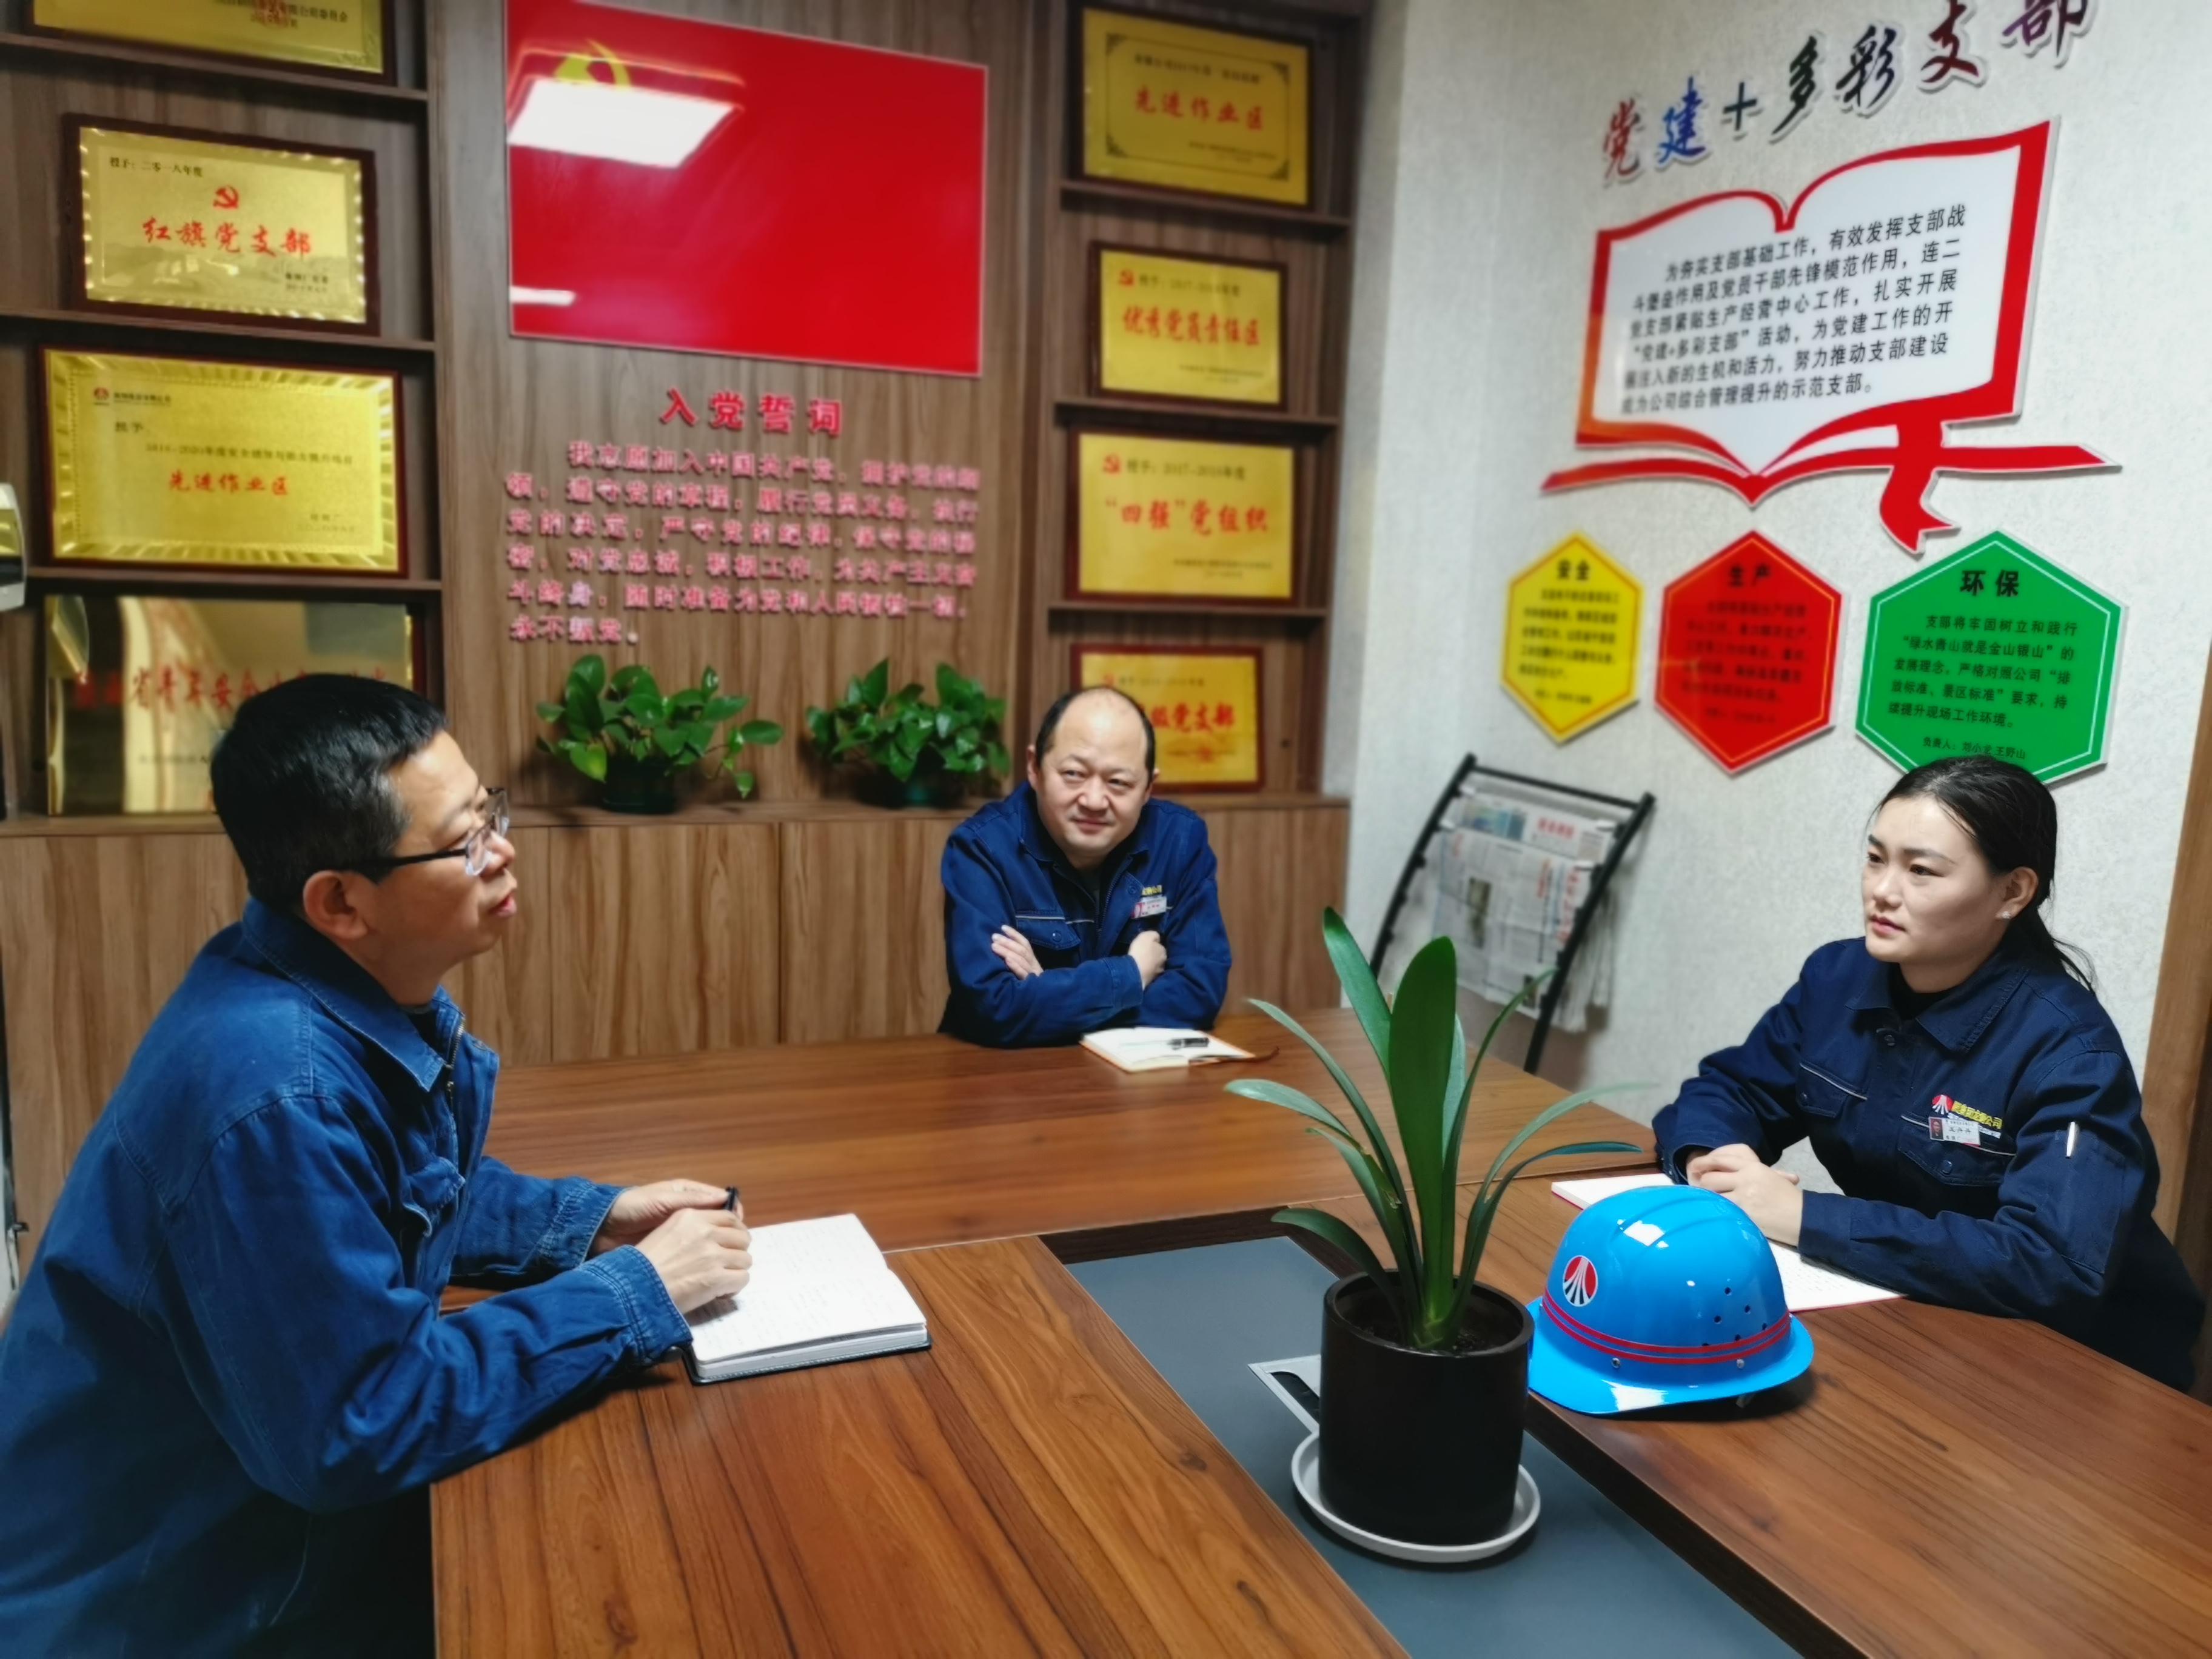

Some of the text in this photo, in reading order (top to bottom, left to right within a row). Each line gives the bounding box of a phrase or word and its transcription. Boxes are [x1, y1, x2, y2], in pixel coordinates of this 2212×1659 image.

[1603, 0, 2088, 178] 党建+多彩支部
[1136, 85, 1263, 130] 先进作业区
[142, 216, 311, 257] 红旗党支部
[1666, 204, 1966, 283] 为夯实支部基础工作，有效发挥支部战
[1123, 306, 1259, 346] 优秀党员责任区
[660, 387, 843, 438] 入党誓词
[169, 470, 289, 495] 先进作业区
[1557, 560, 1590, 581] 安全
[1729, 563, 1771, 587] 生产
[1959, 569, 2020, 597] 环保
[1925, 615, 2077, 637] 支部将牢固树立和践行
[1888, 702, 2013, 728] 续提升现场工作环境。
